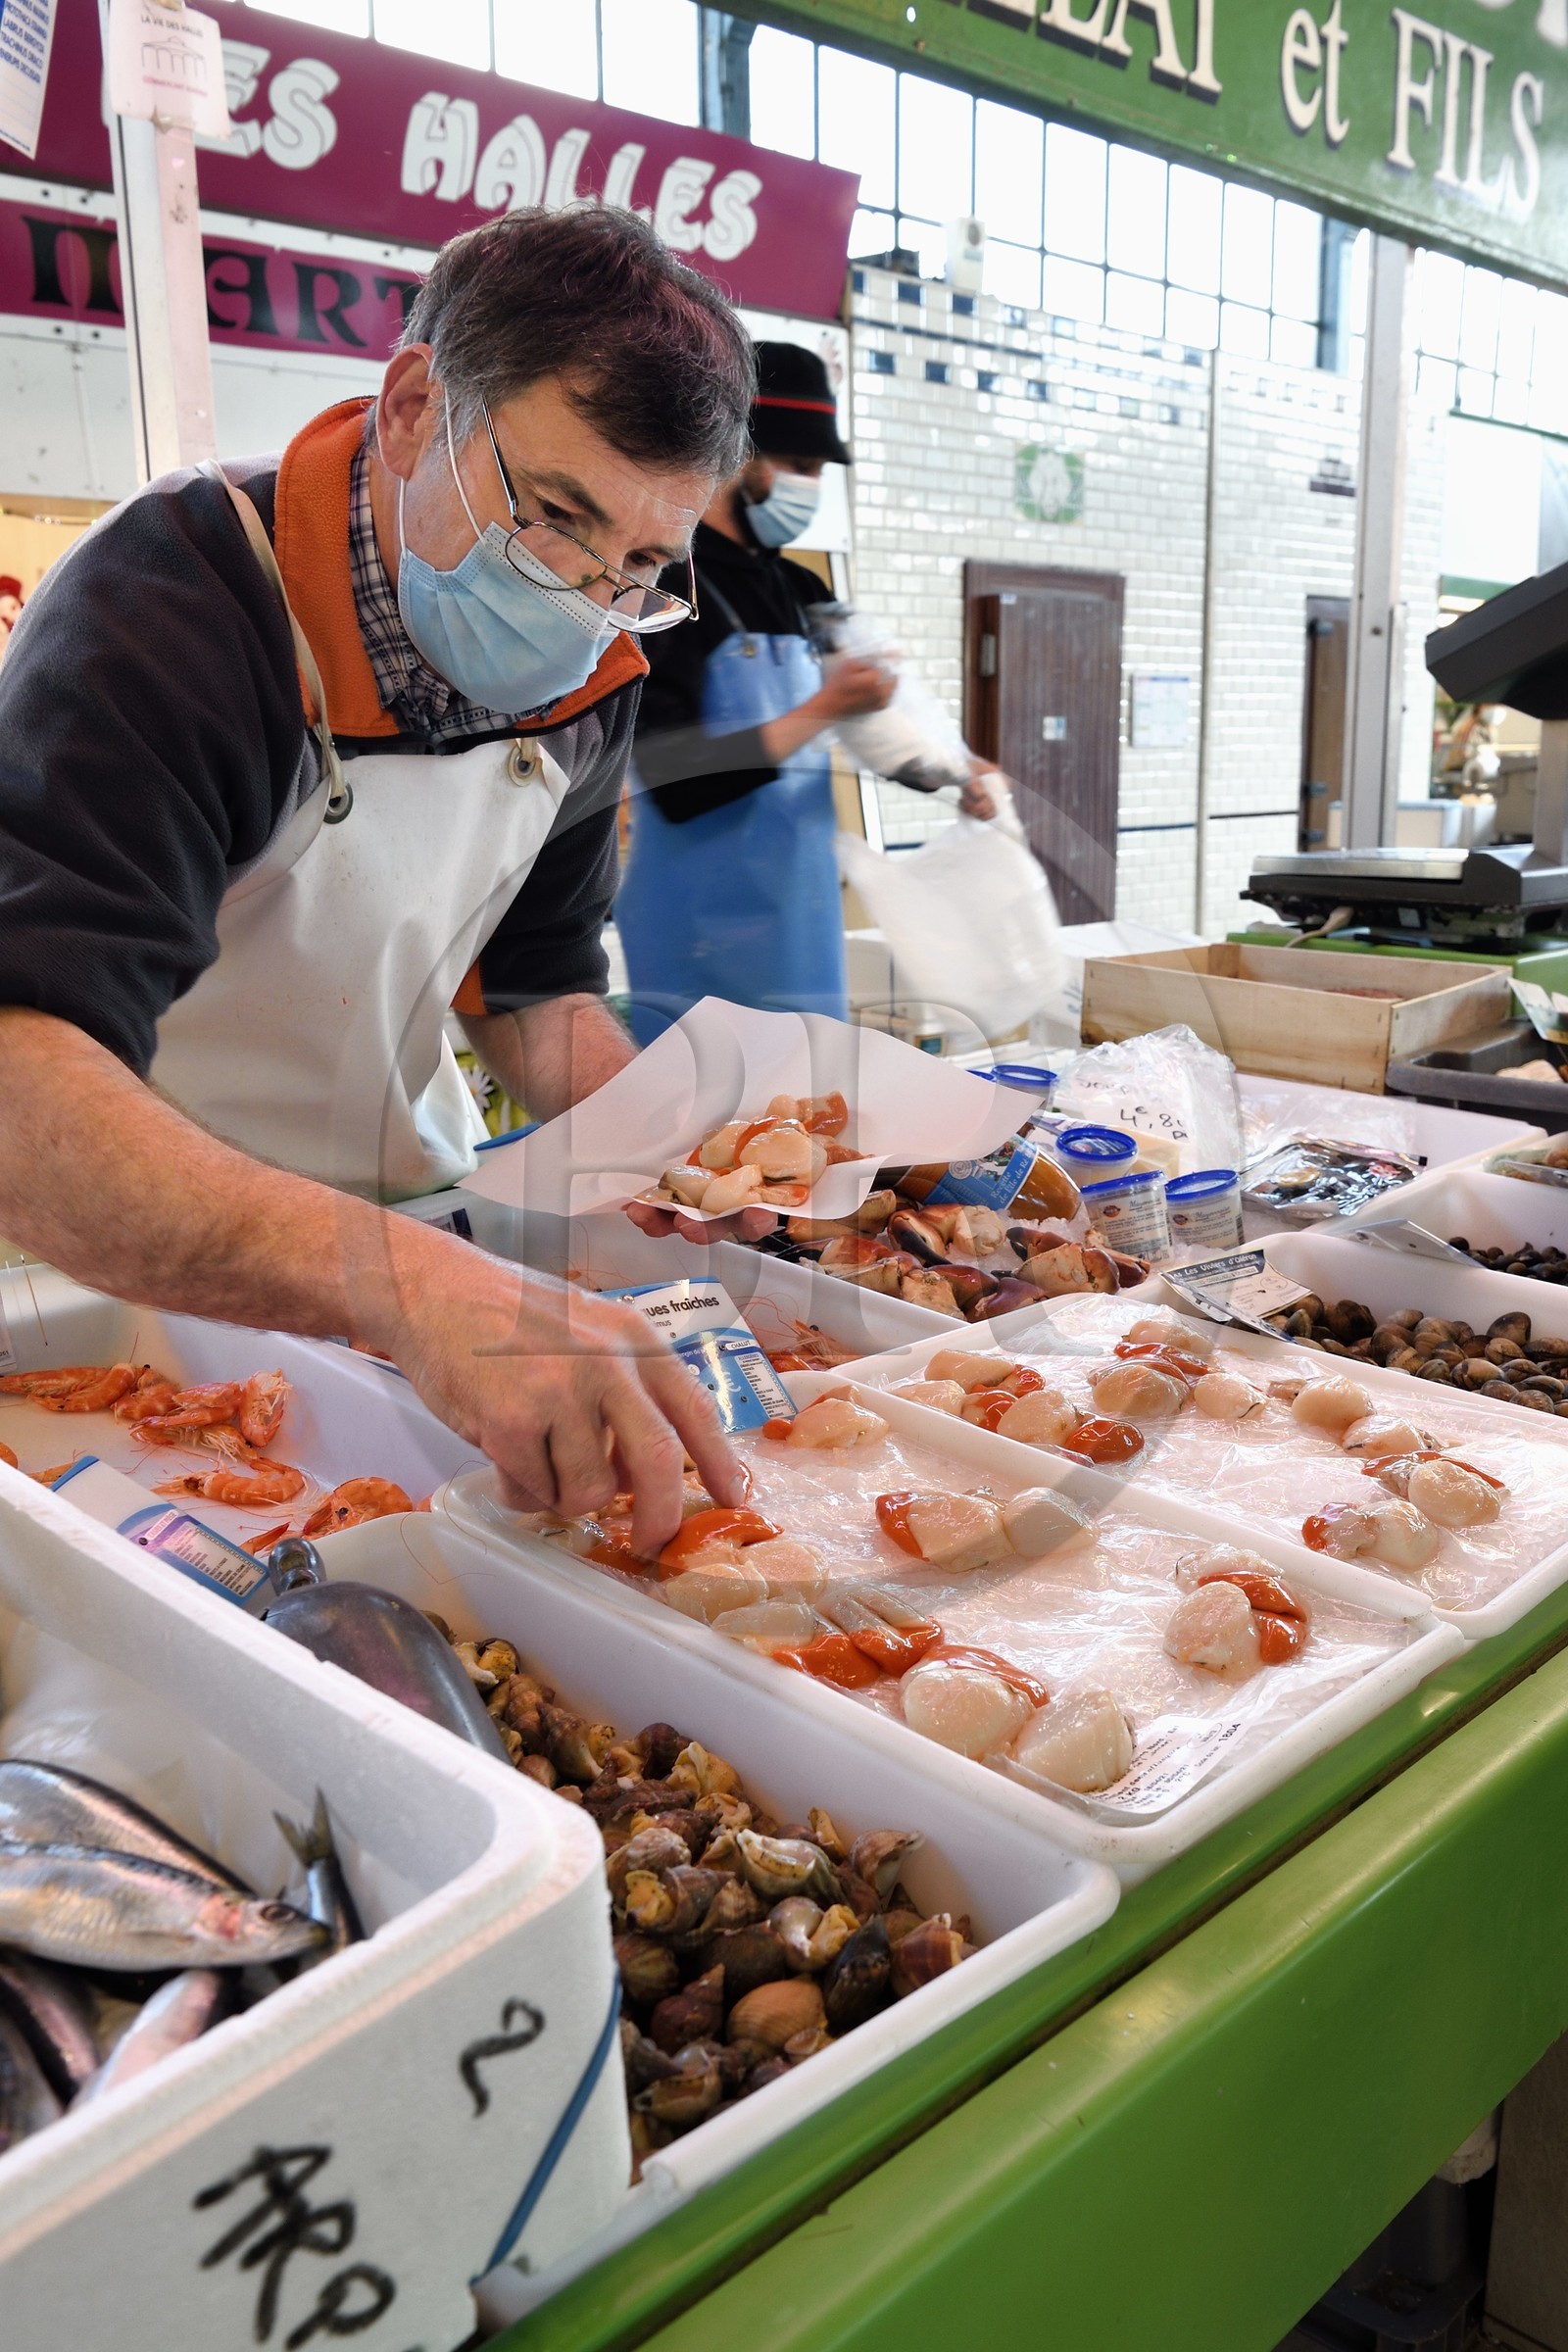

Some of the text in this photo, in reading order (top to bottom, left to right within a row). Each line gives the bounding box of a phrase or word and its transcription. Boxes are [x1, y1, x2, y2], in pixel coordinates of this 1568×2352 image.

[1281, 0, 1544, 215] et FILS
[401, 90, 763, 263] HALLES
[1184, 1267, 1199, 1276] Les
[1200, 1260, 1226, 1272] Viviers
[669, 1296, 720, 1313] fraîches
[731, 1340, 752, 1349] CHALUT
[1218, 1722, 1242, 1742] 1804
